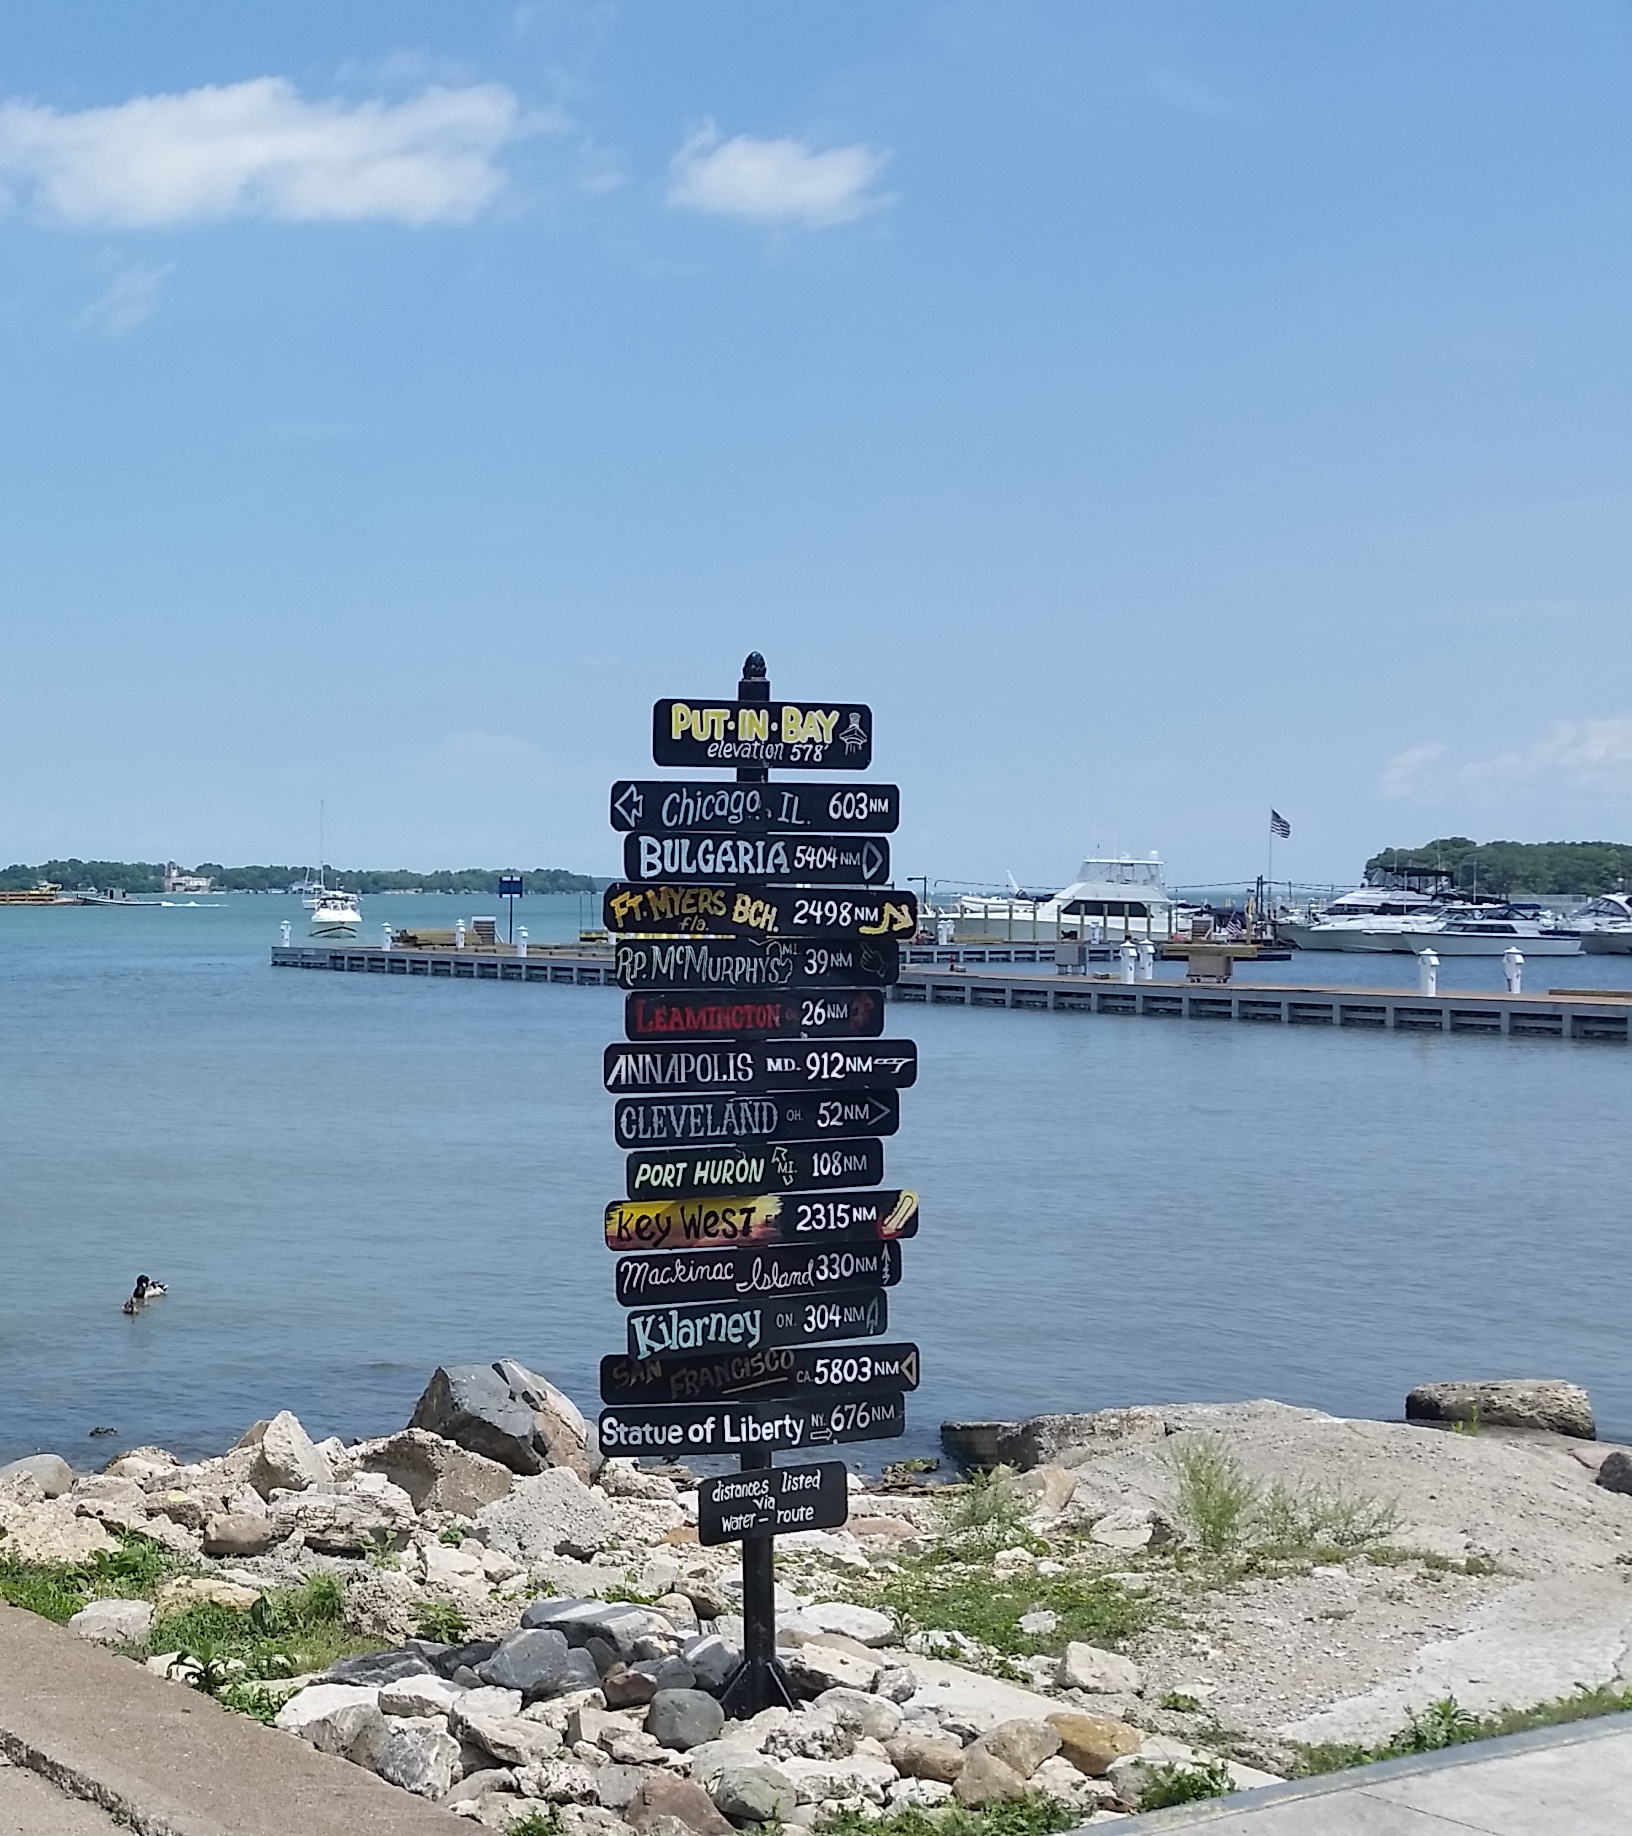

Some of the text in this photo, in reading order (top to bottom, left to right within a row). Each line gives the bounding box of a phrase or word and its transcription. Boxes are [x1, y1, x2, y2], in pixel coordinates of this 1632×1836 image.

[708, 740, 784, 761] elevation
[639, 836, 790, 879] BULGARIA
[648, 886, 727, 921] MYERS
[732, 893, 779, 932] BCH.
[635, 998, 781, 1033] LEAMINGTON
[606, 1053, 754, 1086] ANNAPOLIS
[619, 1100, 778, 1140] CLEVELAND
[634, 1162, 688, 1189] PORT
[693, 1157, 765, 1185] HURON
[620, 1259, 734, 1294] Mackinac
[736, 1257, 815, 1293] Island
[631, 1308, 762, 1360] Kilarney
[612, 1360, 663, 1390] SAN
[670, 1350, 795, 1400] FRANCISCO
[602, 1417, 684, 1445] Statue
[688, 1416, 716, 1443] of
[724, 1414, 804, 1445] Liberty
[712, 1469, 821, 1502] distances listed
[752, 1494, 776, 1510] via
[777, 1506, 814, 1524] route
